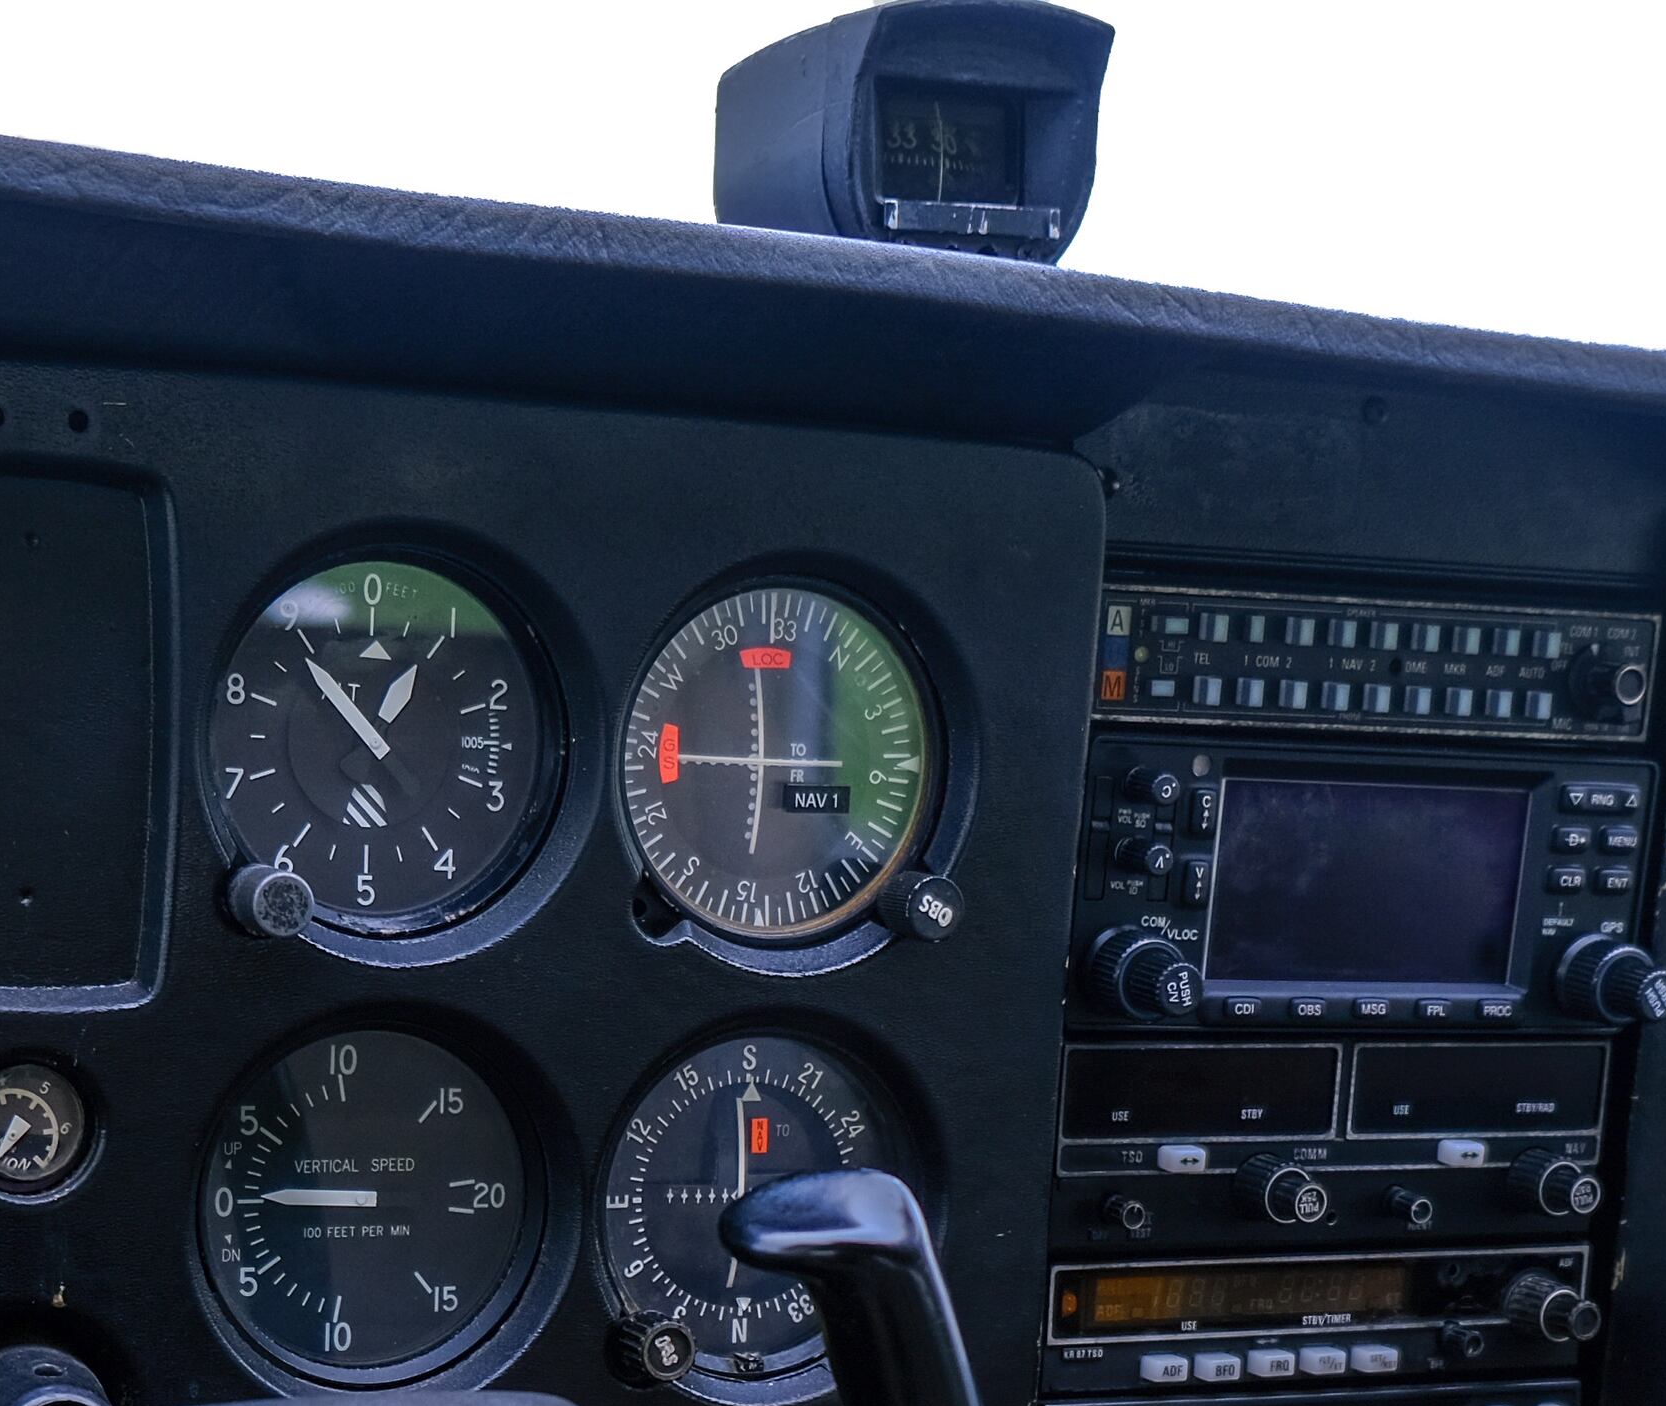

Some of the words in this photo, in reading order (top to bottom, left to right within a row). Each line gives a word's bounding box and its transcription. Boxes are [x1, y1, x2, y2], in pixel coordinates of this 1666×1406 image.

[711, 624, 738, 651] 30
[1193, 652, 1211, 666] TEL
[1405, 661, 1427, 673] DME
[1444, 663, 1466, 676] MKR
[225, 672, 246, 705] 8
[790, 744, 806, 757] TO
[225, 767, 245, 800] 7
[789, 770, 804, 783] FR
[486, 780, 505, 812] 3
[794, 793, 828, 808] NAV
[1608, 836, 1637, 848] MENU
[434, 849, 456, 880] 4
[1110, 881, 1125, 890] VOL
[1560, 875, 1581, 887] CLR
[1607, 878, 1628, 889] ENT
[356, 875, 376, 906] 5
[918, 892, 953, 927] OBS
[1600, 922, 1624, 933] GPS
[1178, 972, 1192, 1007] PUSH
[1235, 1004, 1255, 1015] CDI
[1298, 1004, 1321, 1016] OBS
[1361, 1003, 1386, 1014] MSG
[1427, 1005, 1445, 1017] FPL
[1484, 1005, 1512, 1017] PROC
[330, 1045, 357, 1076] 10
[673, 1064, 700, 1090] 15
[797, 1062, 824, 1089] 21
[438, 1087, 464, 1115] 15
[1112, 1111, 1129, 1122] USE
[1241, 1109, 1264, 1120] STBY
[1393, 1105, 1410, 1115] USE
[239, 1106, 259, 1136] 5
[840, 1110, 866, 1138] 24
[626, 1119, 651, 1144] 12
[776, 1124, 790, 1137] TO
[224, 1142, 242, 1156] UP
[1293, 1148, 1327, 1161] COMM
[294, 1159, 359, 1174] VERTICAL
[370, 1158, 415, 1172] SPEED
[215, 1187, 234, 1217] 0
[472, 1182, 505, 1209] 20
[303, 1226, 321, 1239] 100
[327, 1226, 356, 1238] FEET
[362, 1226, 384, 1238] PER
[390, 1225, 410, 1237] MIN
[221, 1248, 241, 1263] DN
[238, 1266, 258, 1298] 5
[433, 1285, 458, 1312] 15
[1181, 1321, 1197, 1331] USE
[1302, 1314, 1351, 1326] STBY/TIMER
[325, 1321, 352, 1352] 10
[1163, 1365, 1183, 1377] ADF
[1216, 1365, 1235, 1377] BFO
[1270, 1361, 1289, 1372] FRQ
